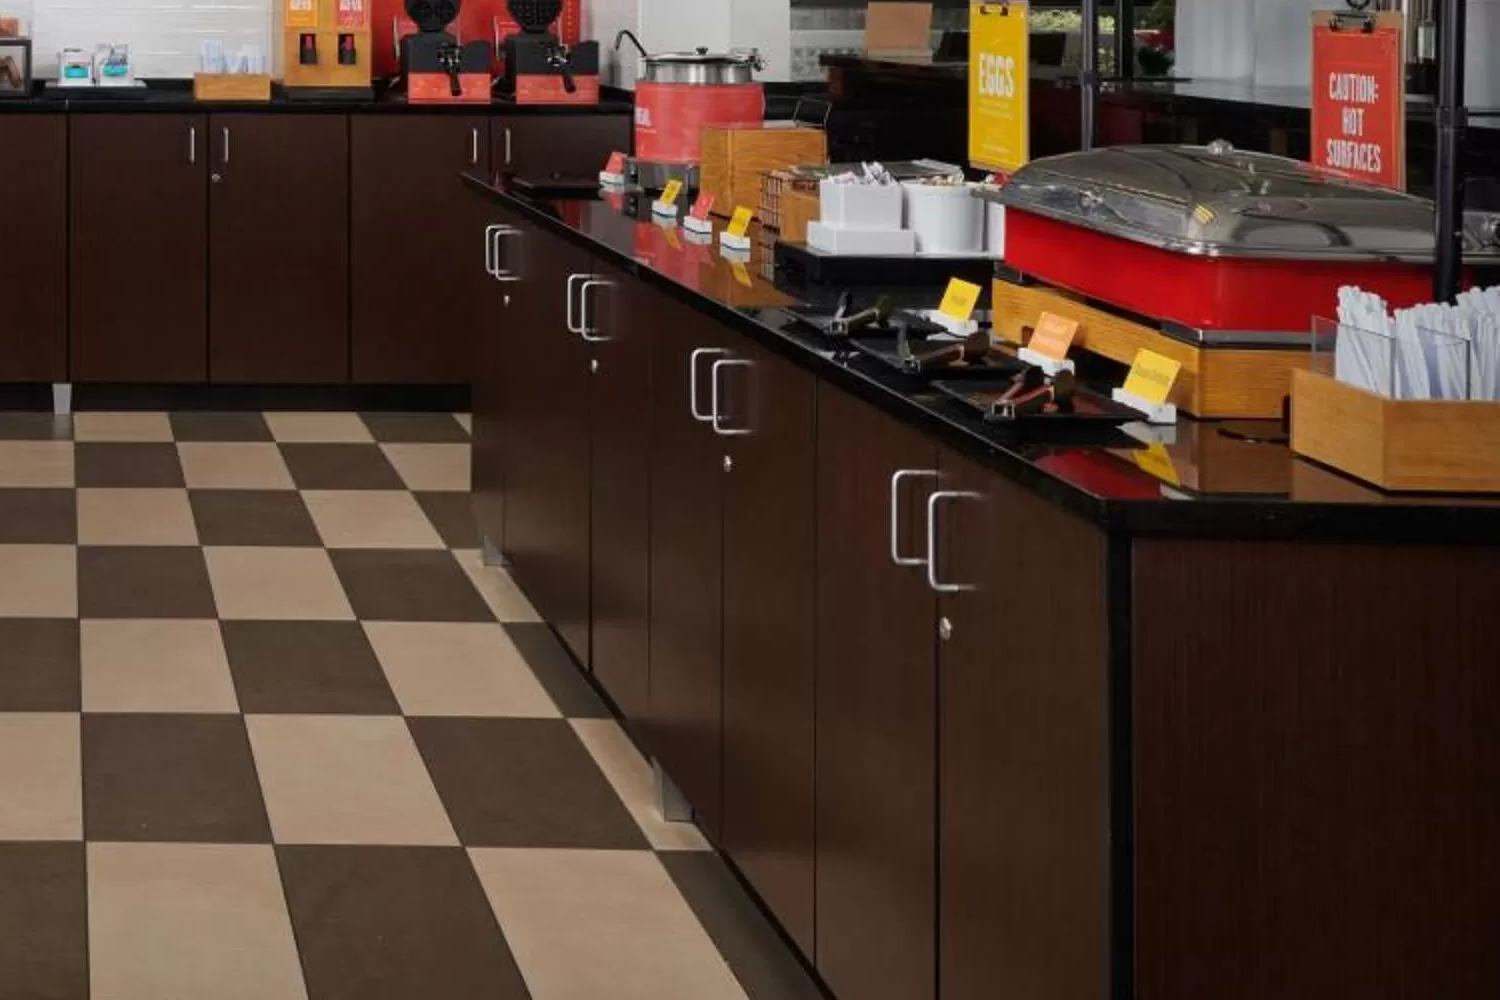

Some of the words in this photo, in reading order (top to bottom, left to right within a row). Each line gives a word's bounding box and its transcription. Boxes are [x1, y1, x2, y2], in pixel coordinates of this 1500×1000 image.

[979, 53, 1015, 98] EGGS
[1328, 72, 1380, 104] CAUTION:
[1342, 106, 1365, 137] HOT
[1326, 138, 1381, 174] SURFACES
